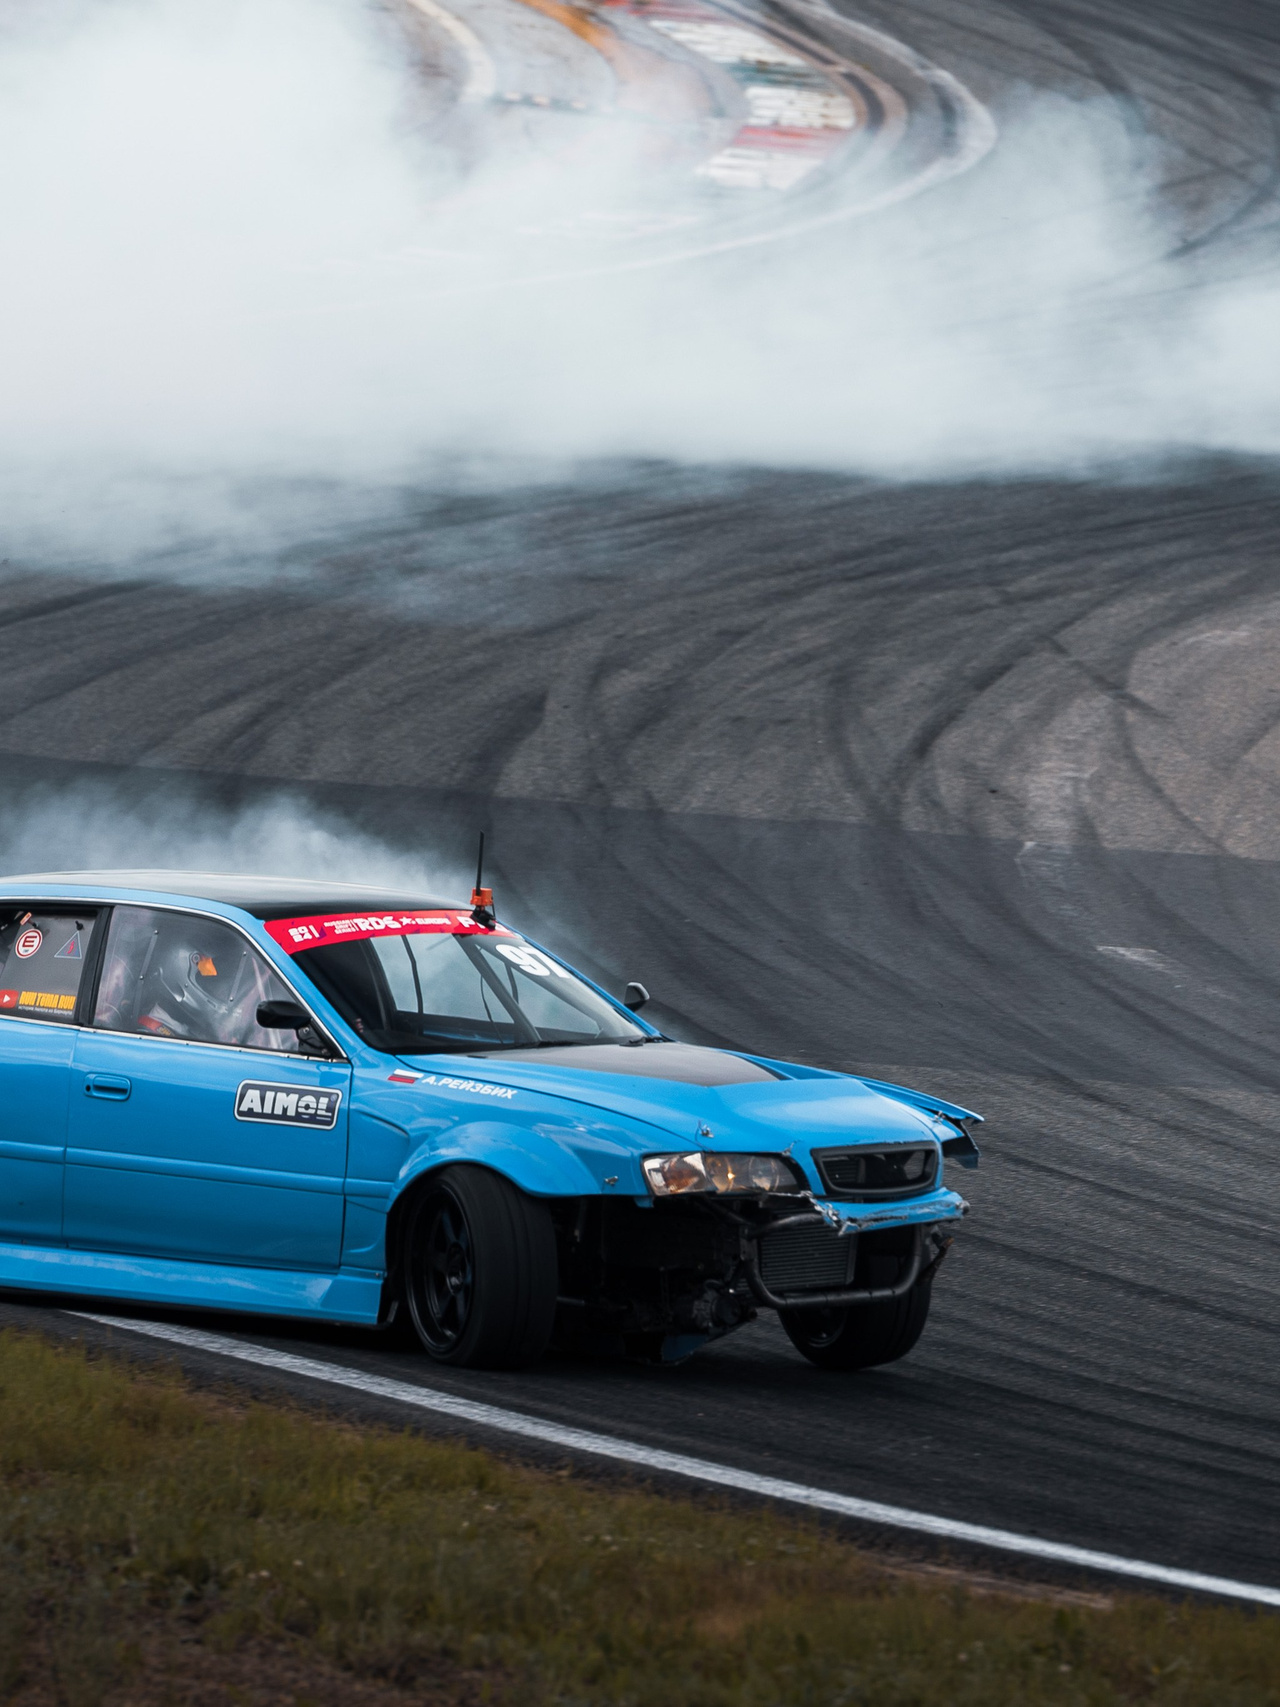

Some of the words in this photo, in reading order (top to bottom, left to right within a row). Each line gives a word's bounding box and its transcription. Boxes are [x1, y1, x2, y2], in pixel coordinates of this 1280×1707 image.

[353, 916, 401, 931] RDS
[22, 936, 37, 947] E
[19, 991, 37, 1006] RUN
[58, 995, 76, 1010] RUN
[421, 1075, 518, 1100] А.РЕЙЗБИХ
[239, 1089, 332, 1121] AIMOL
